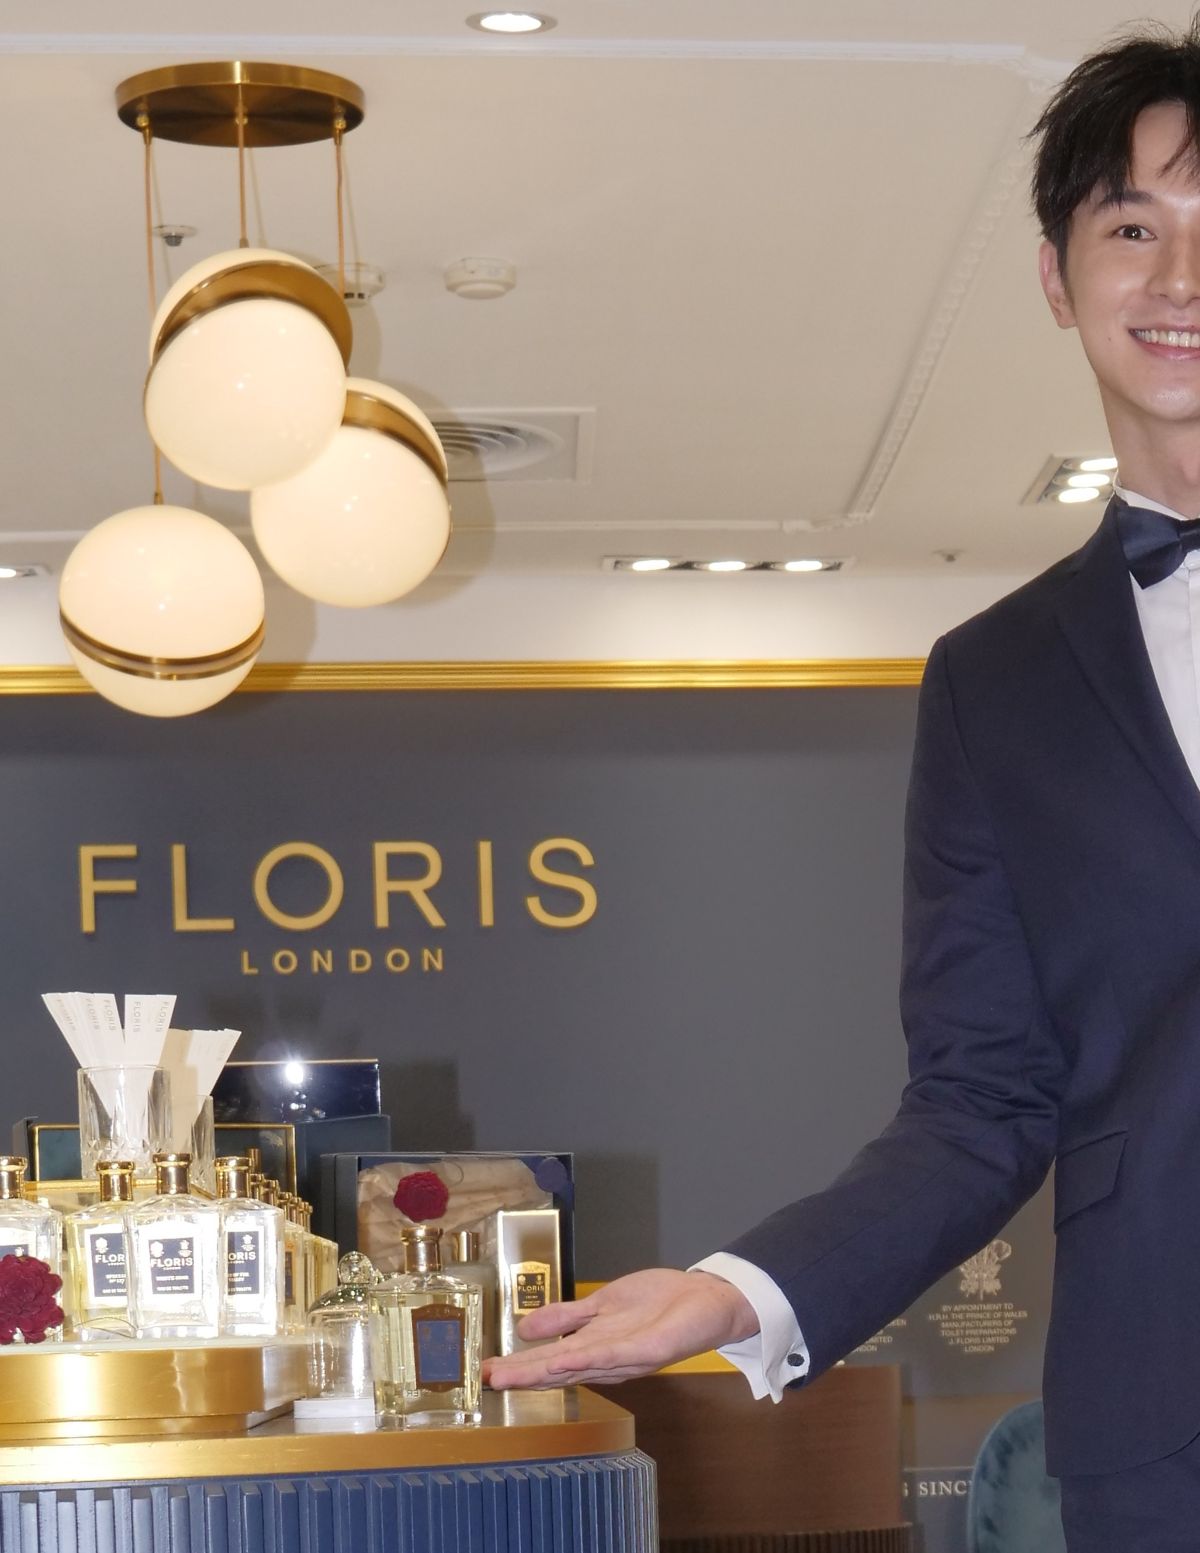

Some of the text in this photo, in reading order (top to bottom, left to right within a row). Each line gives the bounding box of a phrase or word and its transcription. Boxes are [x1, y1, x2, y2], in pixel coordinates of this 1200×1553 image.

[78, 837, 598, 934] FLORIS
[241, 949, 444, 975] LONDON
[95, 1254, 125, 1264] FLOR
[228, 1251, 257, 1261] ORIS
[150, 1257, 193, 1268] FLORIS
[942, 1302, 1014, 1312] BY APPOINTMENT TO
[951, 1312, 964, 1320] THE
[1003, 1310, 1028, 1318] WALES
[964, 1344, 995, 1352] LONDON
[919, 1480, 972, 1496] SINC
